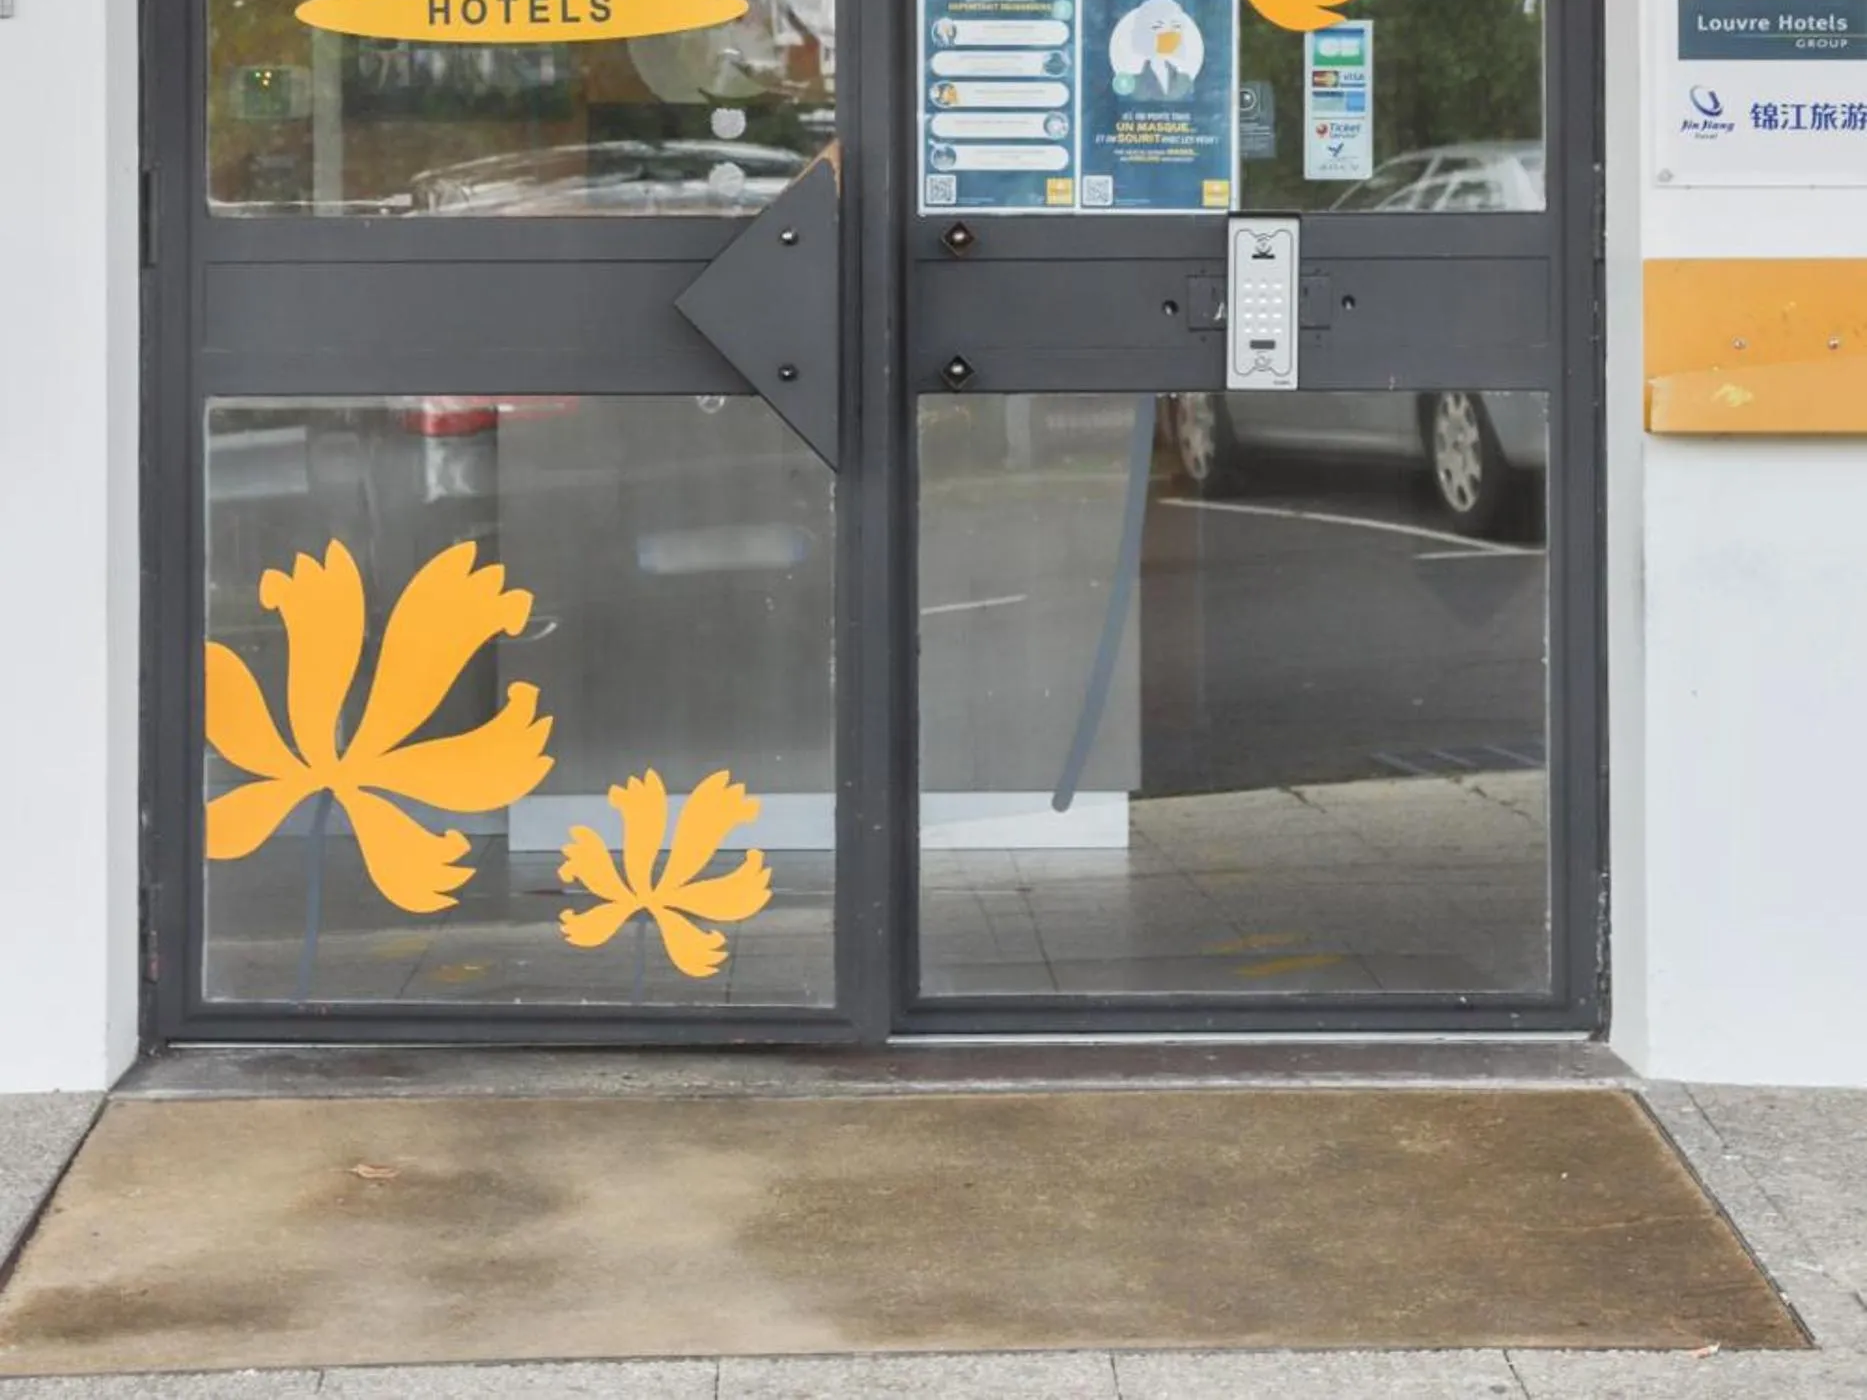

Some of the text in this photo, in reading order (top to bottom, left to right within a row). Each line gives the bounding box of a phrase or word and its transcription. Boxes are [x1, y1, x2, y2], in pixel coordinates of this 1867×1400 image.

[1697, 14, 1848, 31] Louvre Hotels
[1795, 38, 1848, 49] GROUP
[1116, 122, 1134, 132] UN
[1681, 120, 1735, 132] Jin Jiang
